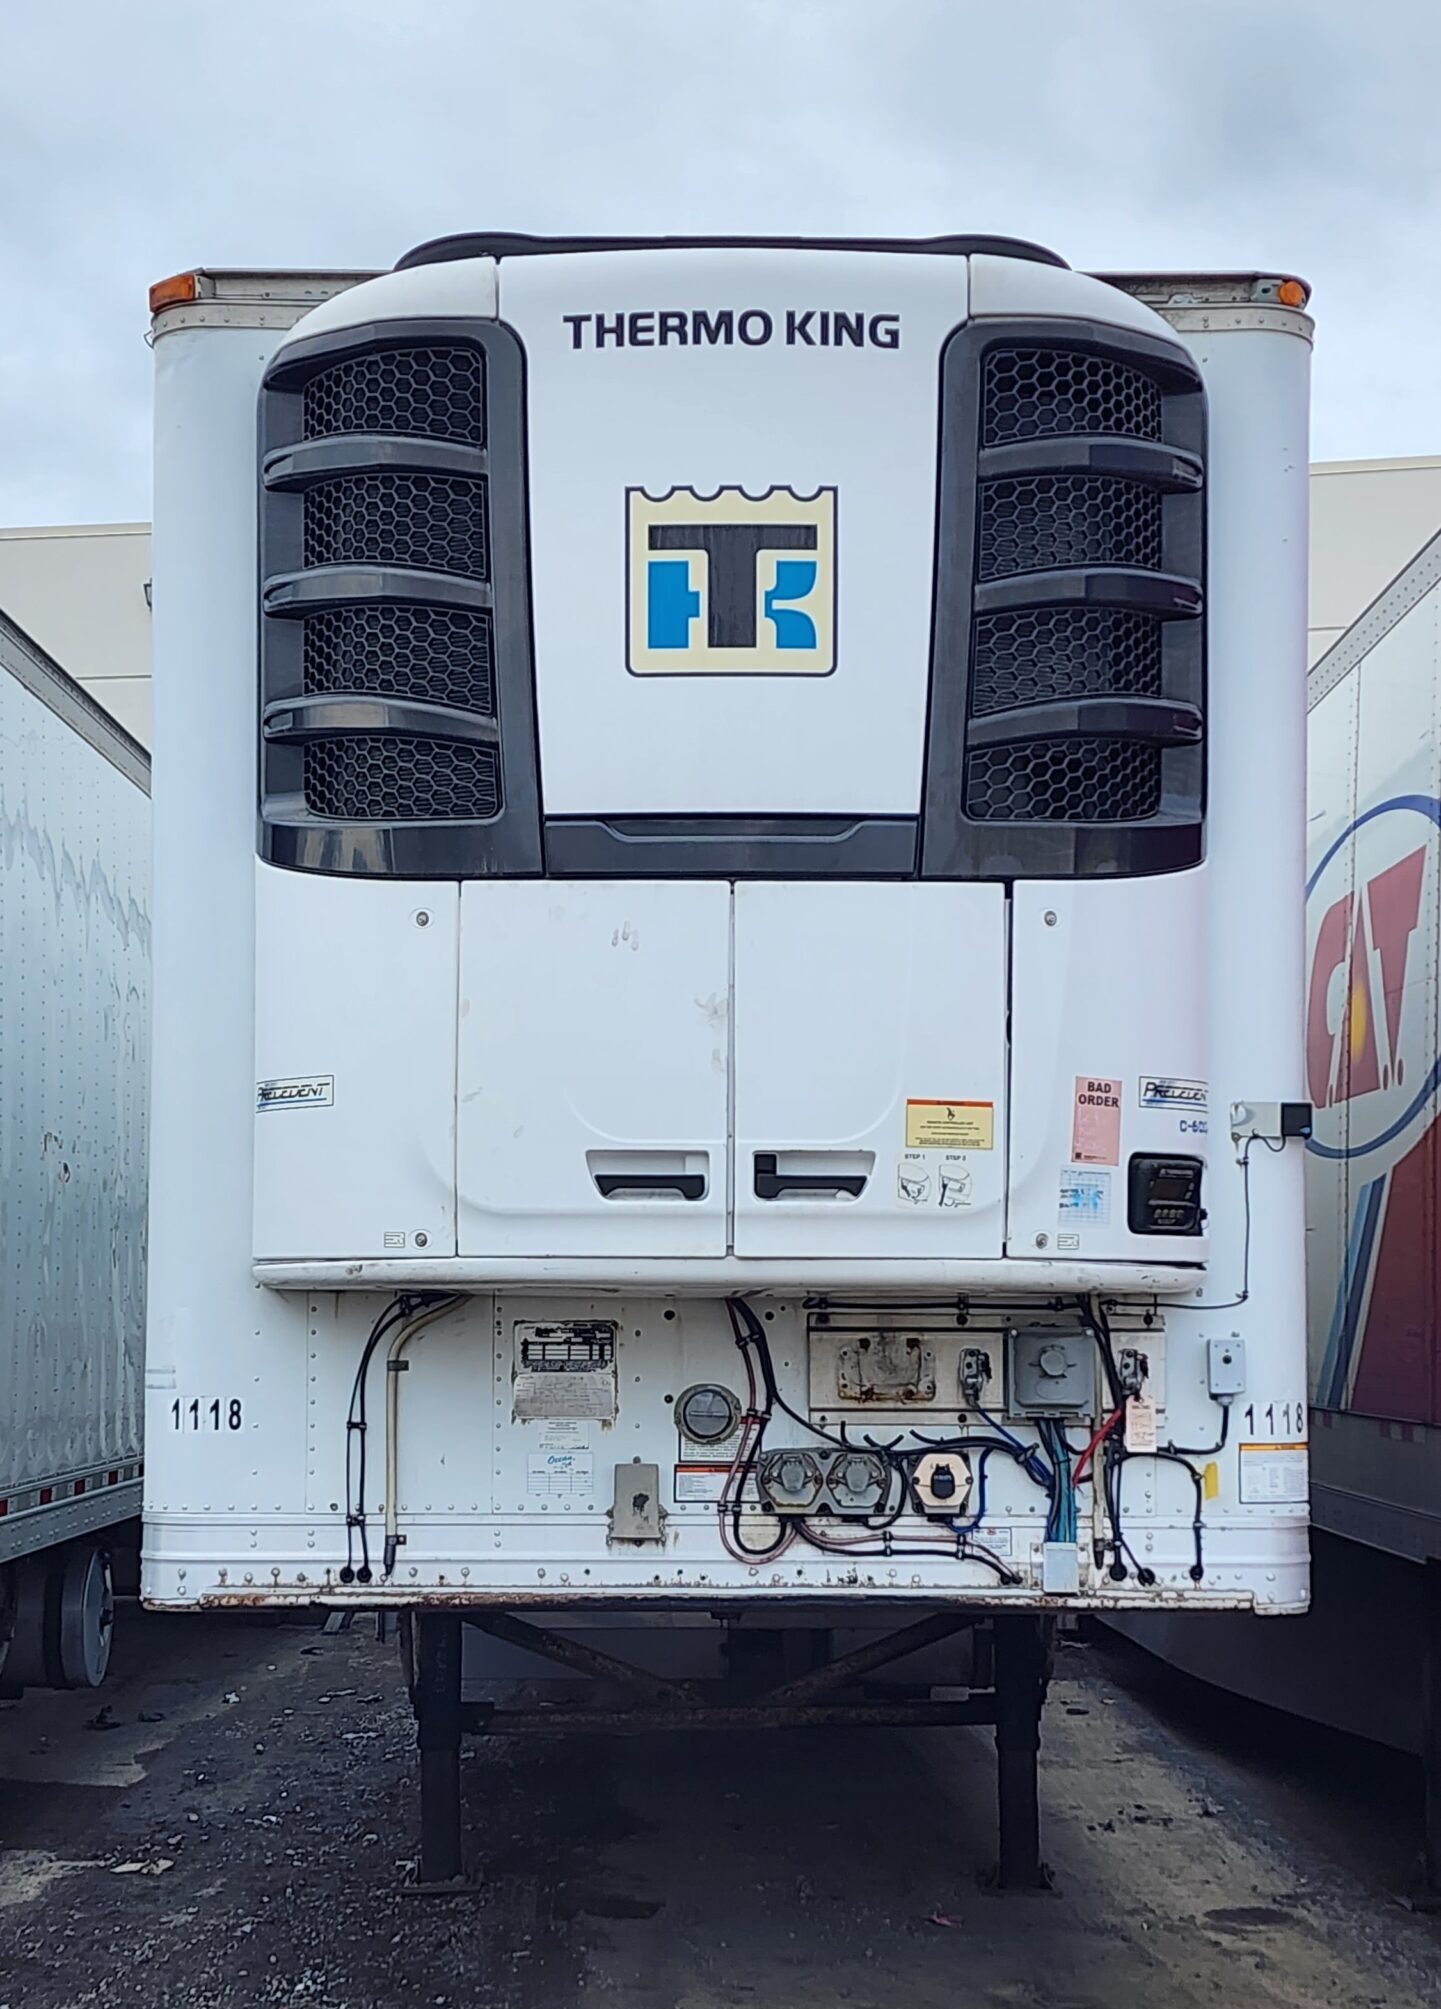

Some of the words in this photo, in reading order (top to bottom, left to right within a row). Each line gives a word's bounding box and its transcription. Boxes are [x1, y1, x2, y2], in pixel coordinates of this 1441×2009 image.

[562, 309, 773, 349] THERMO
[785, 309, 900, 349] KING
[1078, 1093, 1120, 1108] ORDER
[1087, 1081, 1111, 1094] BAD
[171, 1398, 242, 1431] 1118
[1244, 1402, 1304, 1436] 1118
